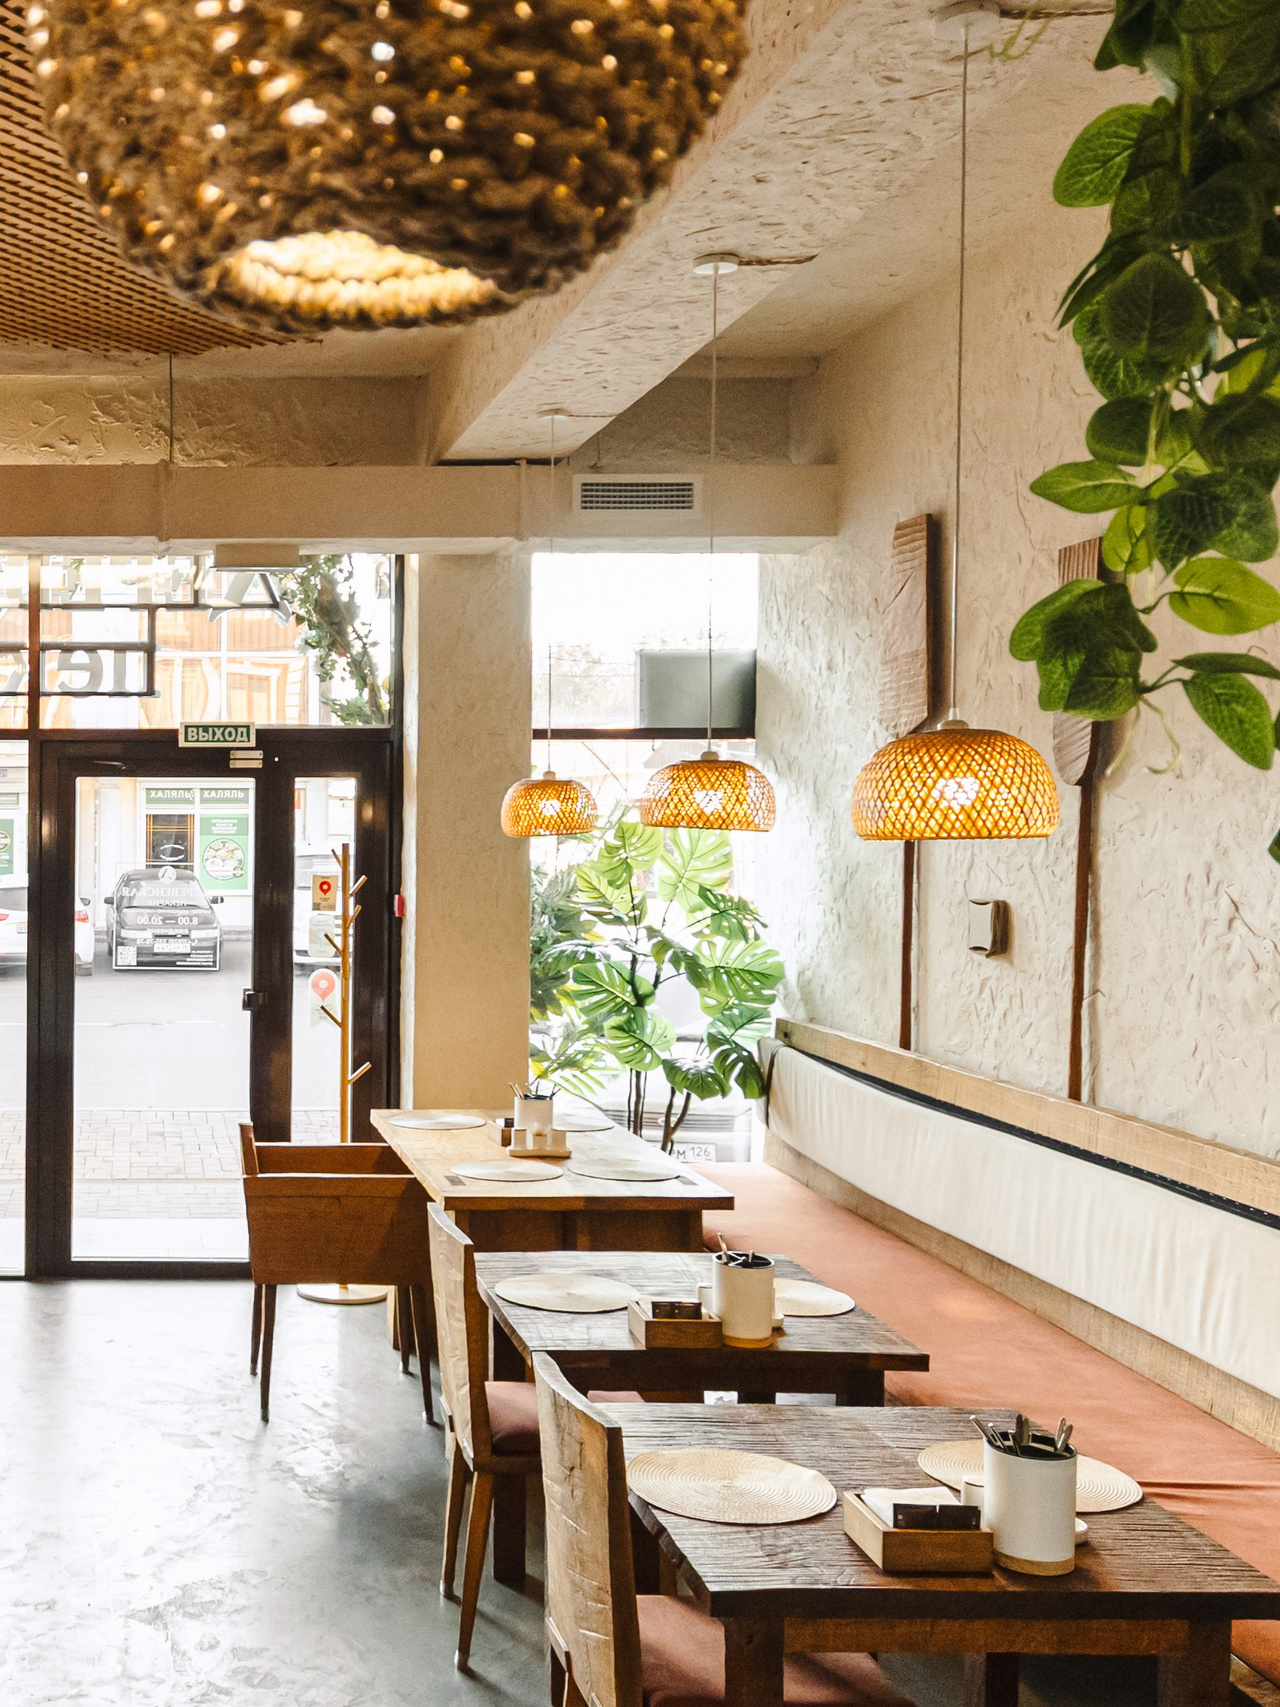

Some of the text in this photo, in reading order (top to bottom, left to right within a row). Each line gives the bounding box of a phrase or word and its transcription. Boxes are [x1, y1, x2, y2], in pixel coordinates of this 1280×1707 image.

[187, 727, 249, 742] ВЫХОД
[150, 790, 191, 798] ХАЛЯЛЬ
[203, 790, 245, 798] ХАЛЯЛЬ
[689, 1146, 711, 1157] 126
